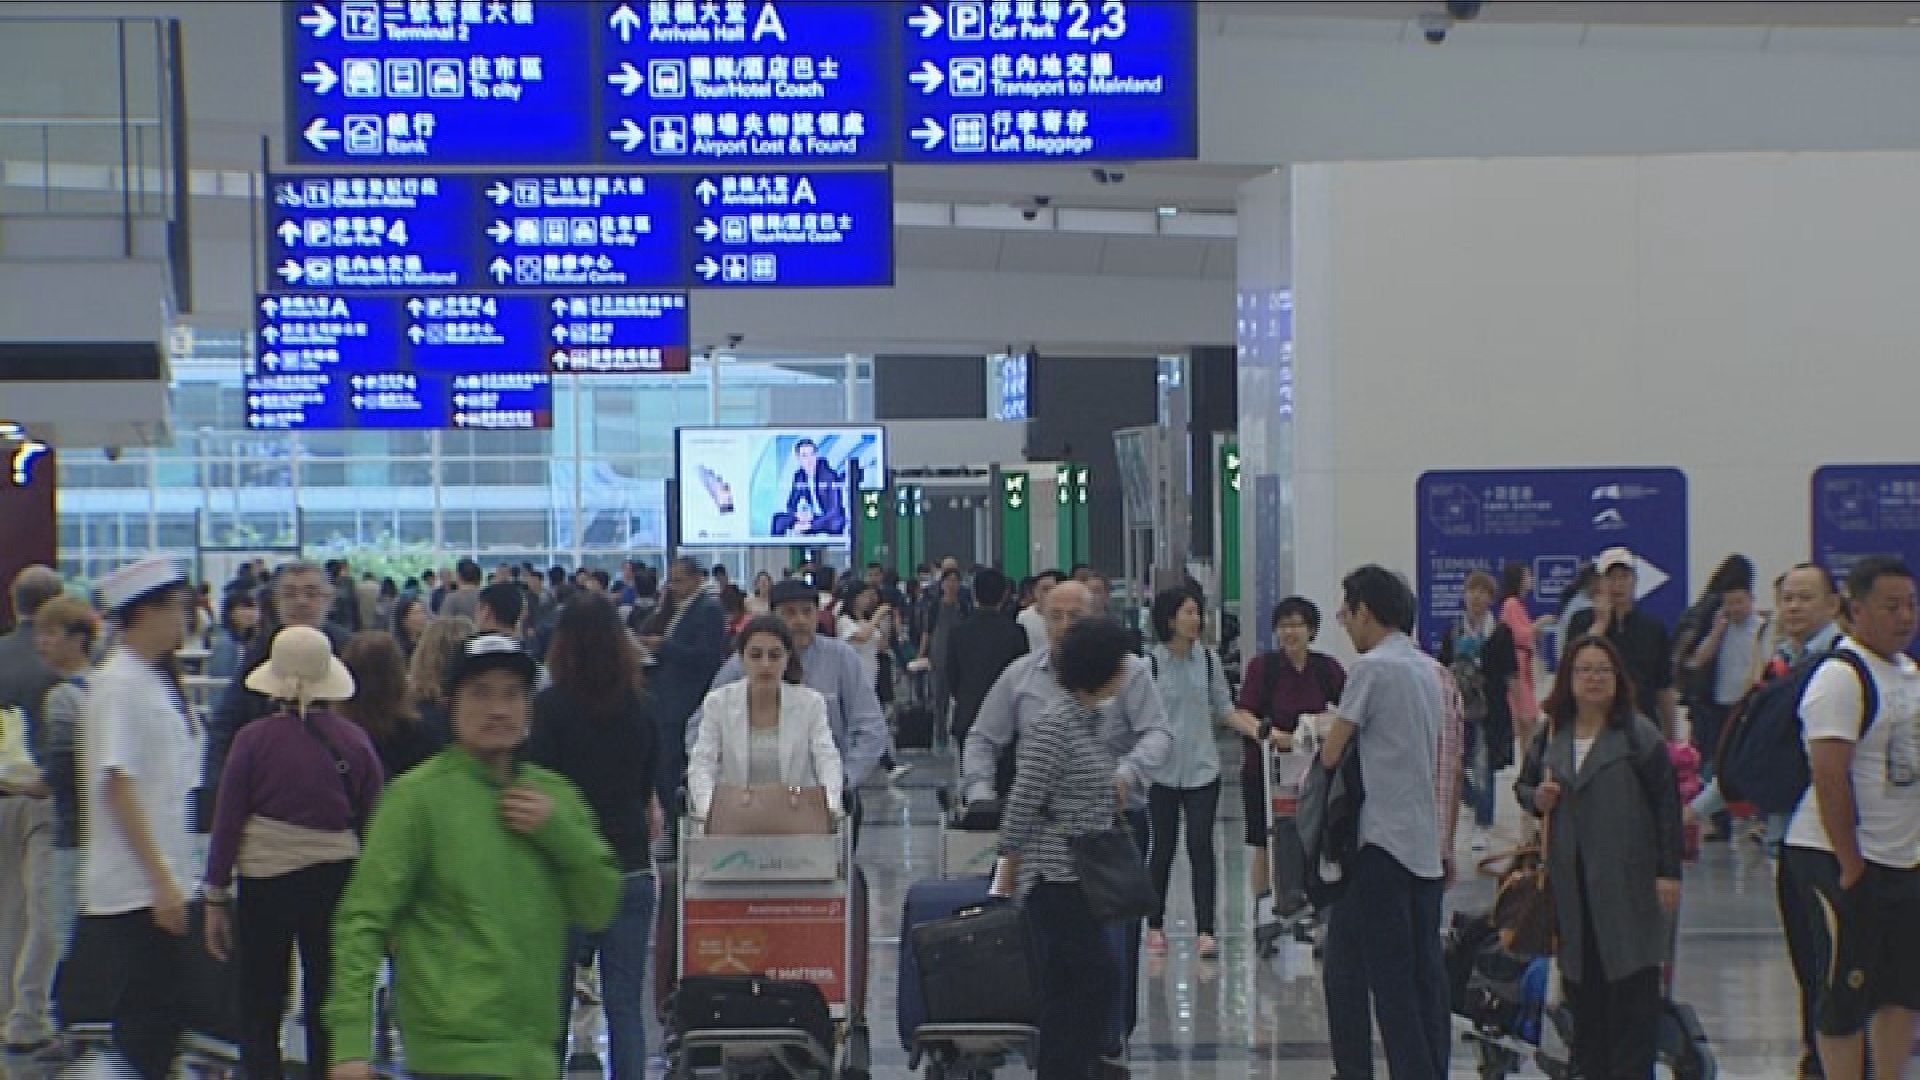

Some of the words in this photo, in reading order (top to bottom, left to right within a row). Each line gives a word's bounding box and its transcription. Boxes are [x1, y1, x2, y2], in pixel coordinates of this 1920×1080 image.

[384, 23, 455, 41] Terminal
[458, 24, 470, 41] 2
[649, 24, 711, 42] Arrivals
[714, 24, 745, 42] Hall
[752, 3, 788, 42] A
[989, 23, 1017, 40] Car
[1021, 23, 1056, 40] Park
[1066, 2, 1127, 45] 2,3
[468, 80, 490, 98] To
[775, 79, 825, 98] Coach
[989, 77, 1065, 99] Transport
[1068, 78, 1086, 97] to
[1088, 74, 1163, 95] Mainland
[386, 137, 428, 155] Bank
[691, 137, 748, 158] Airport
[751, 137, 785, 154] Lost
[788, 137, 804, 154] &
[807, 135, 857, 154] Found
[991, 134, 1020, 152] Left
[1023, 134, 1094, 156] Baggage
[791, 176, 817, 205] A
[386, 218, 409, 247] 4
